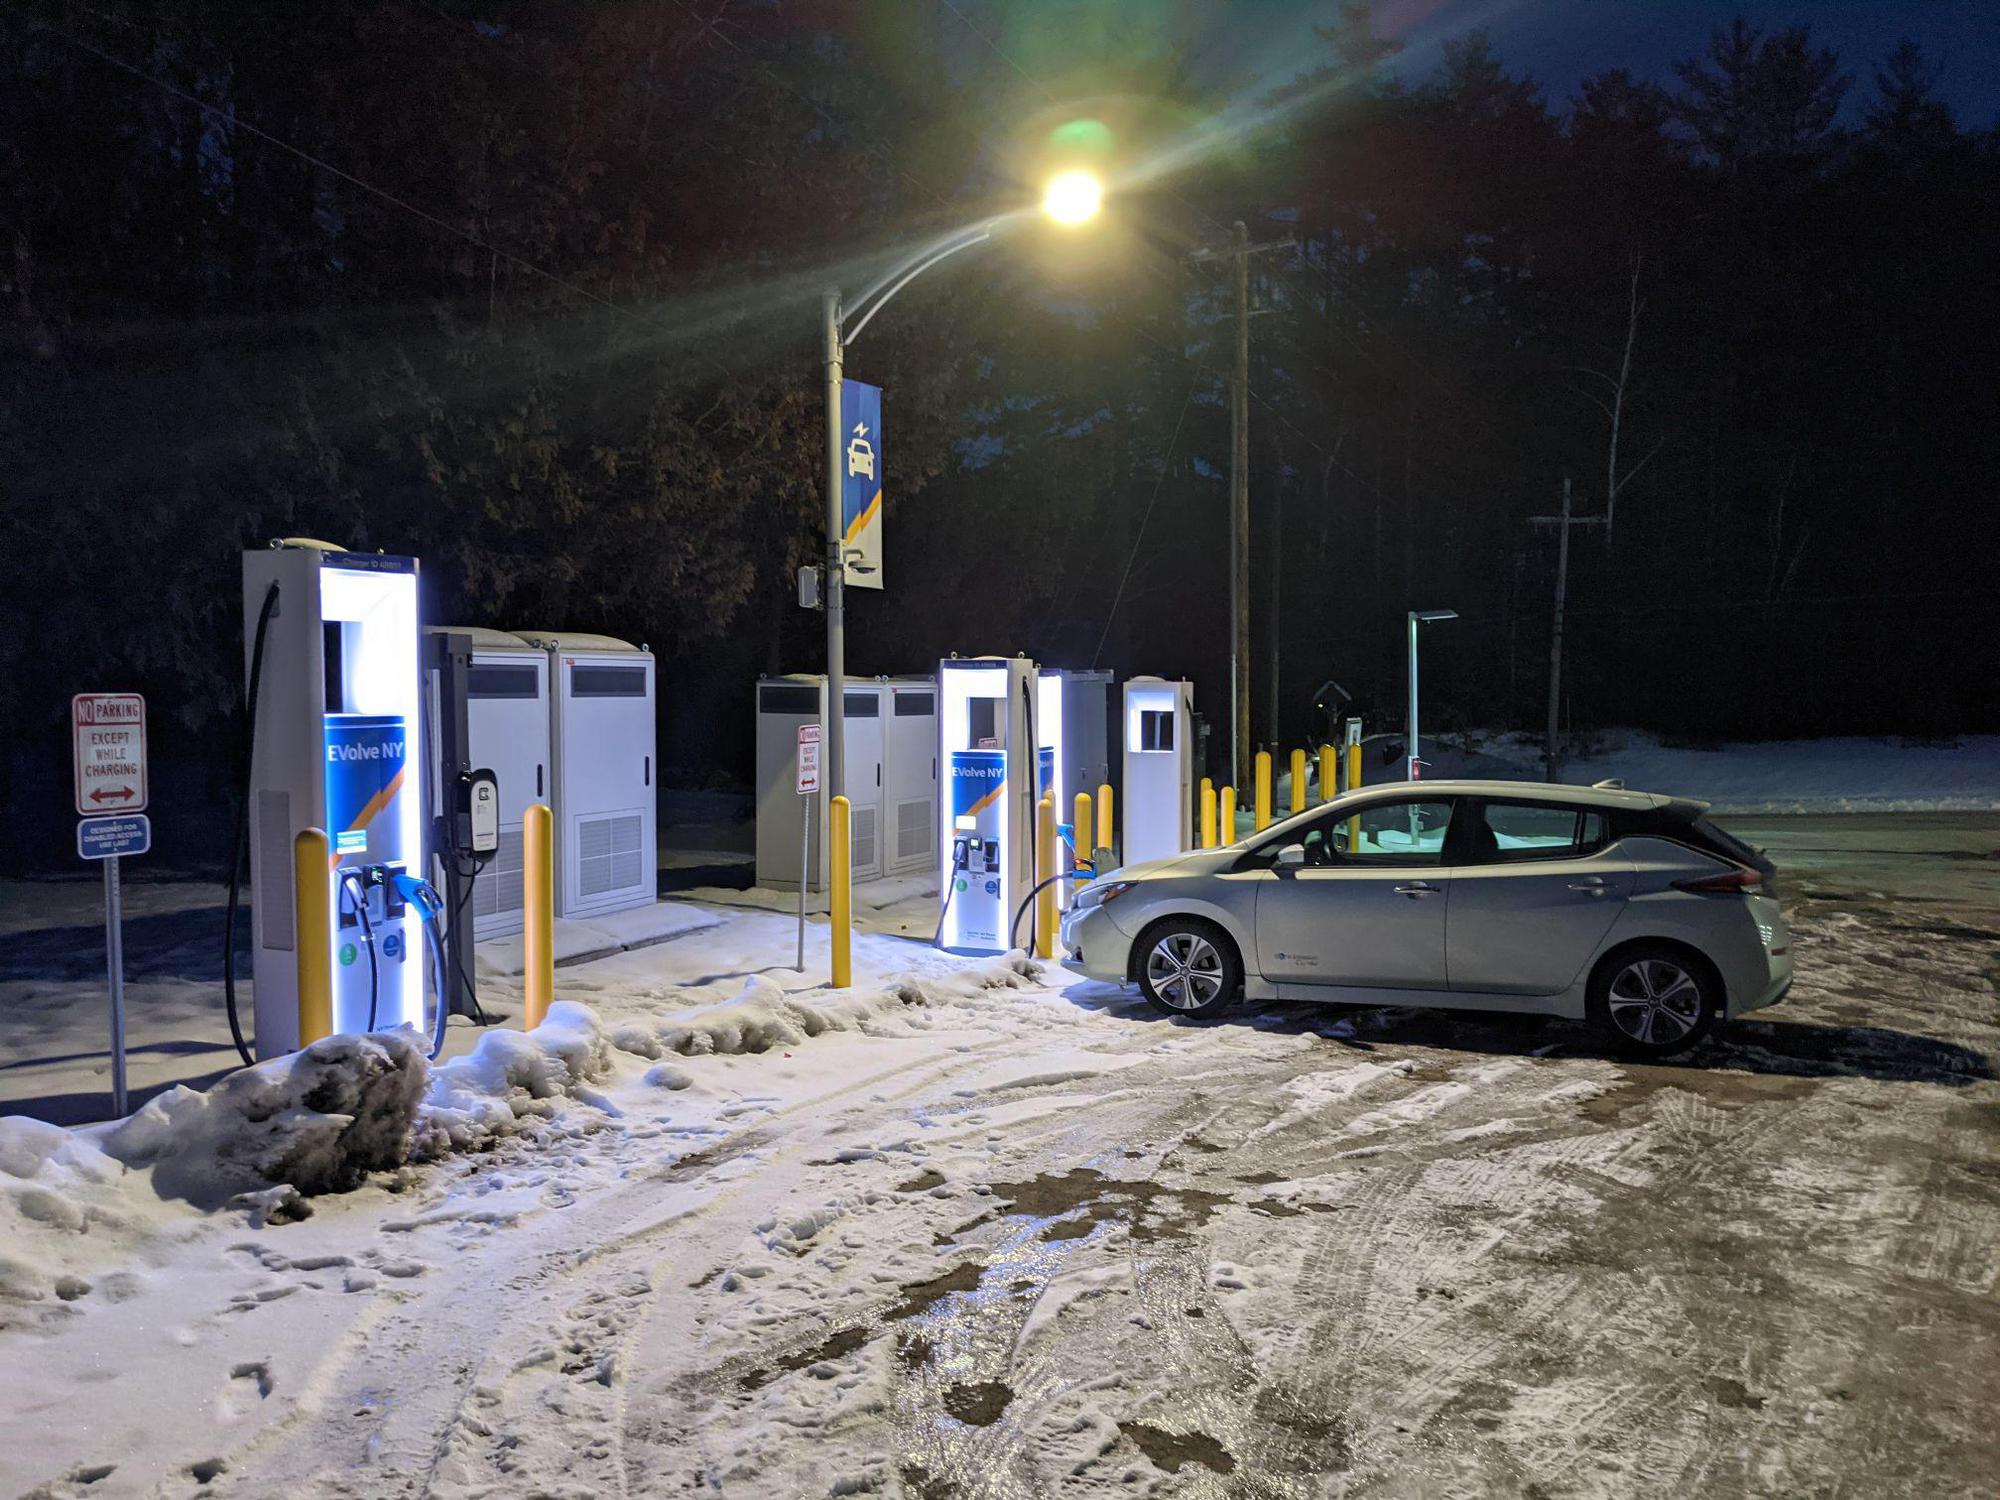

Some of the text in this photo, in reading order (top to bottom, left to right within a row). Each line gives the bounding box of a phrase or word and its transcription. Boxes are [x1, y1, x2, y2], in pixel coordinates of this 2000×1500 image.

[80, 700, 138, 722] NO PARKING
[91, 732, 130, 745] EXCEPT
[95, 747, 126, 761] WHILE
[328, 742, 403, 762] EVolve NY
[85, 763, 137, 777] CHARGING
[952, 766, 1003, 778] EVolve NY
